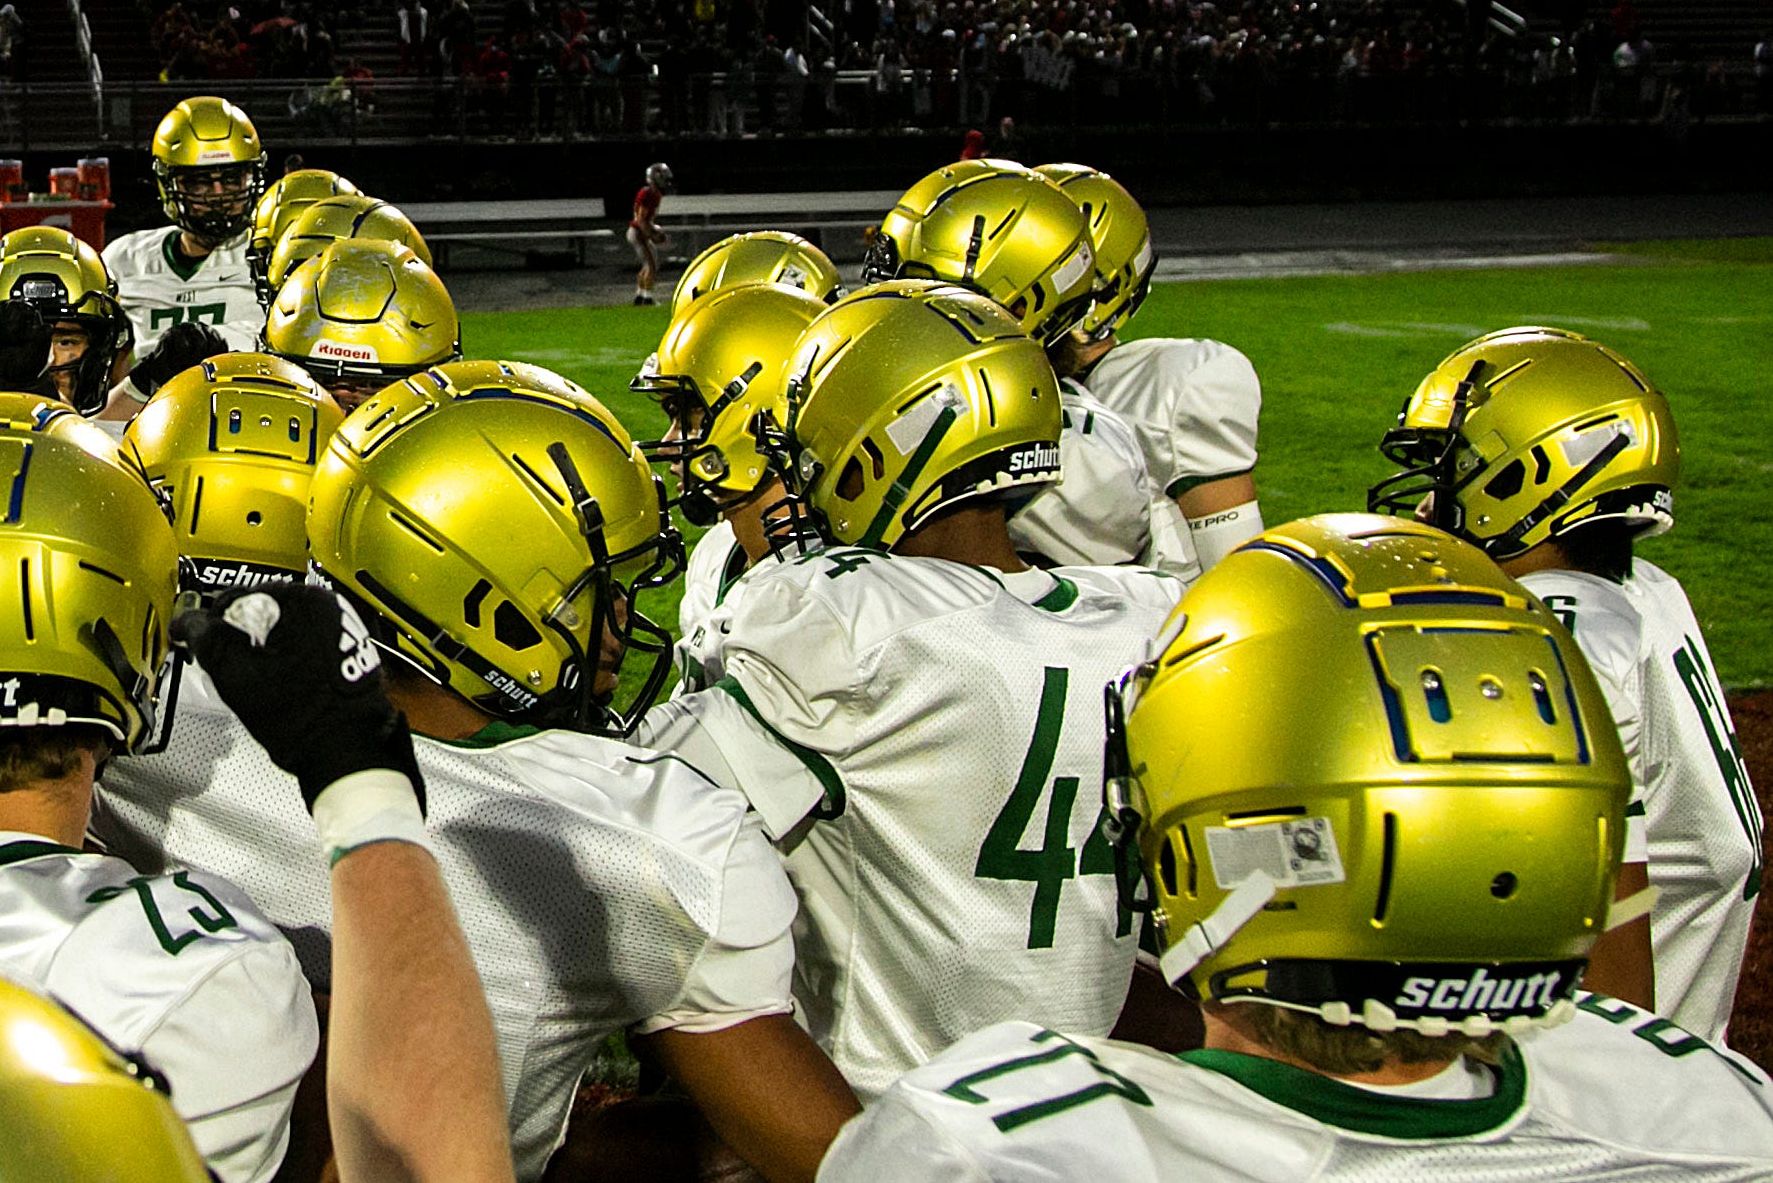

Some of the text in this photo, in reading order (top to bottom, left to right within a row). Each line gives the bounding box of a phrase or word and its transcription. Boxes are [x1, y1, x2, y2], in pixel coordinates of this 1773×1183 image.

[1205, 511, 1239, 528] PRO
[484, 669, 538, 709] schutt
[1394, 968, 1561, 1010] schutt
